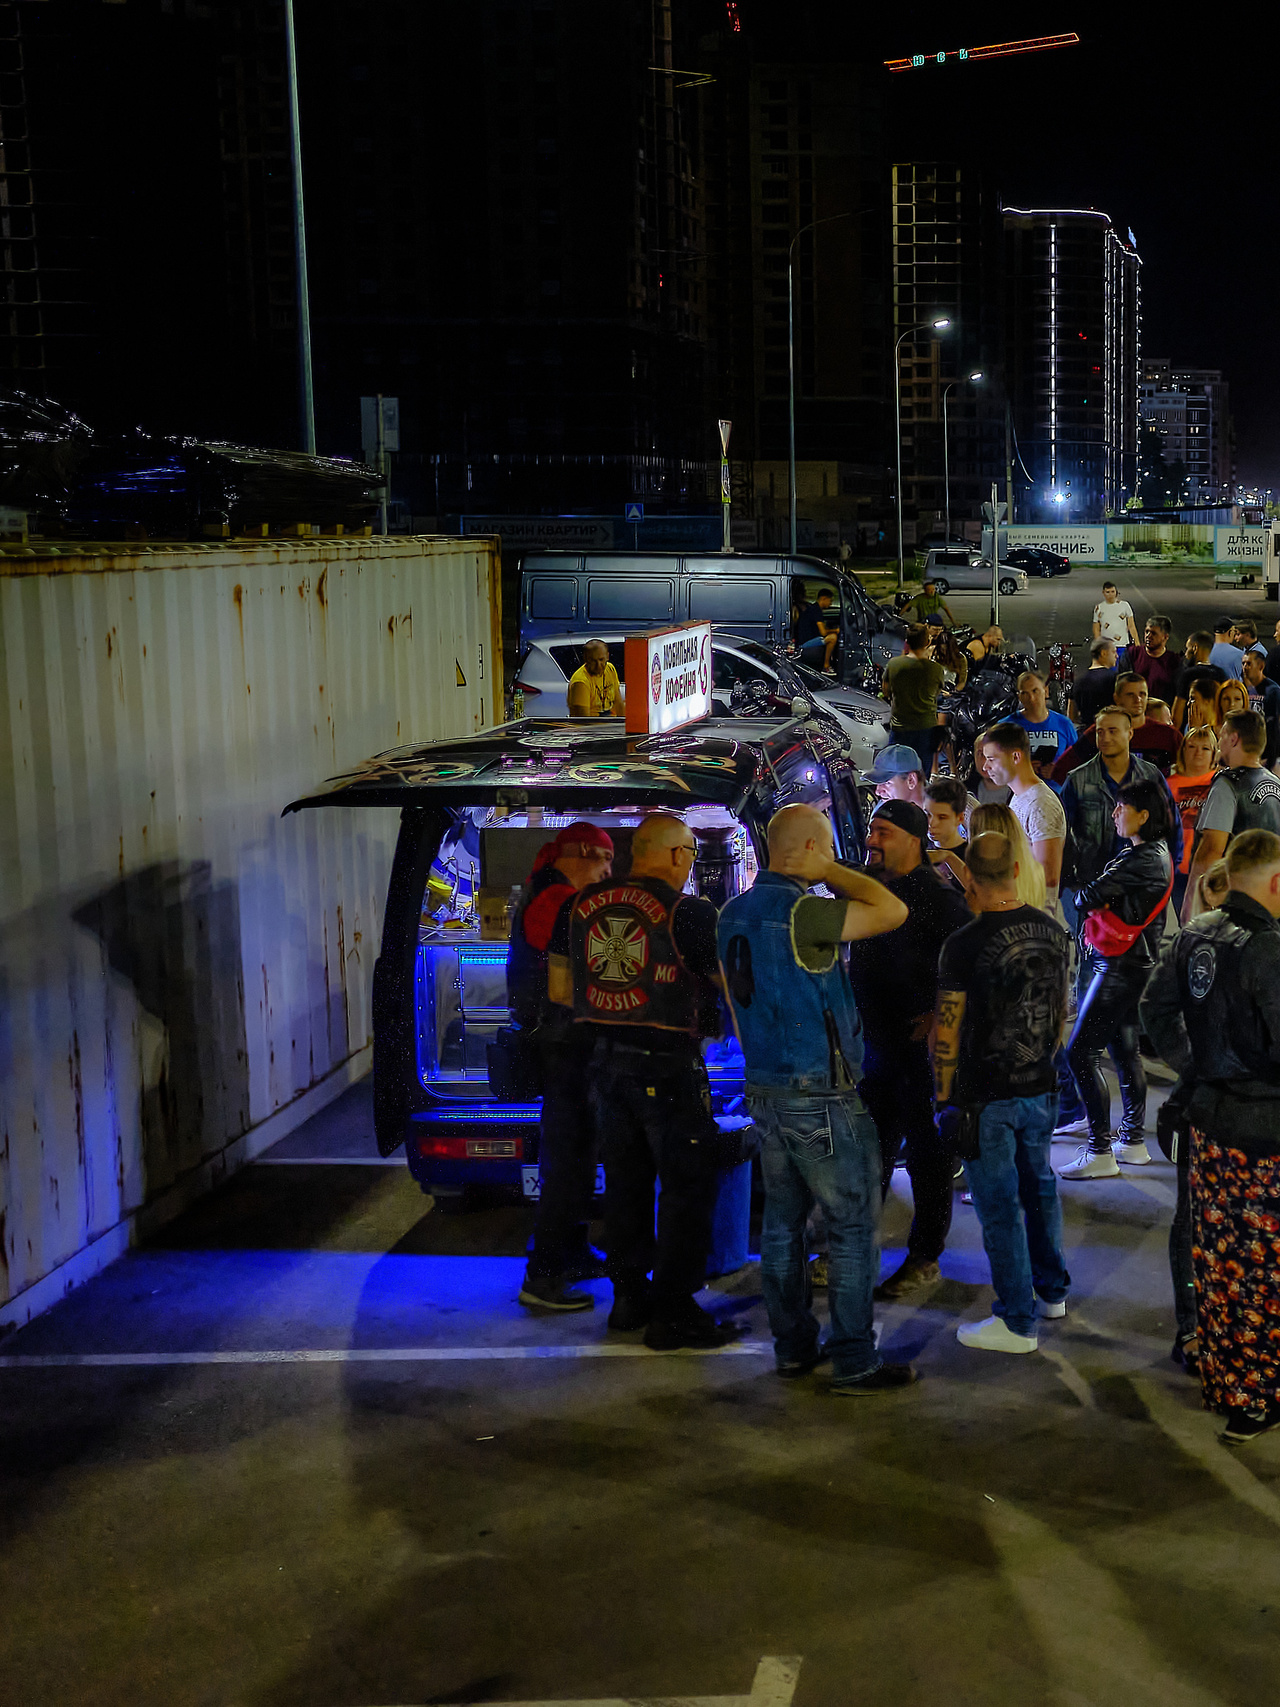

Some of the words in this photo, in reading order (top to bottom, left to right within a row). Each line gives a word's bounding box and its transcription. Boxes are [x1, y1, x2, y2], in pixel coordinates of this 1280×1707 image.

[470, 525, 534, 535] МАГАЗИН
[538, 525, 597, 535] КВАРТИР
[1227, 535, 1249, 545] ДЛЯ
[663, 636, 698, 671] МОБИЛЬНАЯ
[665, 667, 697, 705] КОФЕЙНЯ
[577, 889, 615, 919] LAST
[621, 887, 667, 925] REBELS
[653, 965, 676, 983] MC
[588, 987, 641, 1011] RUSSIA
